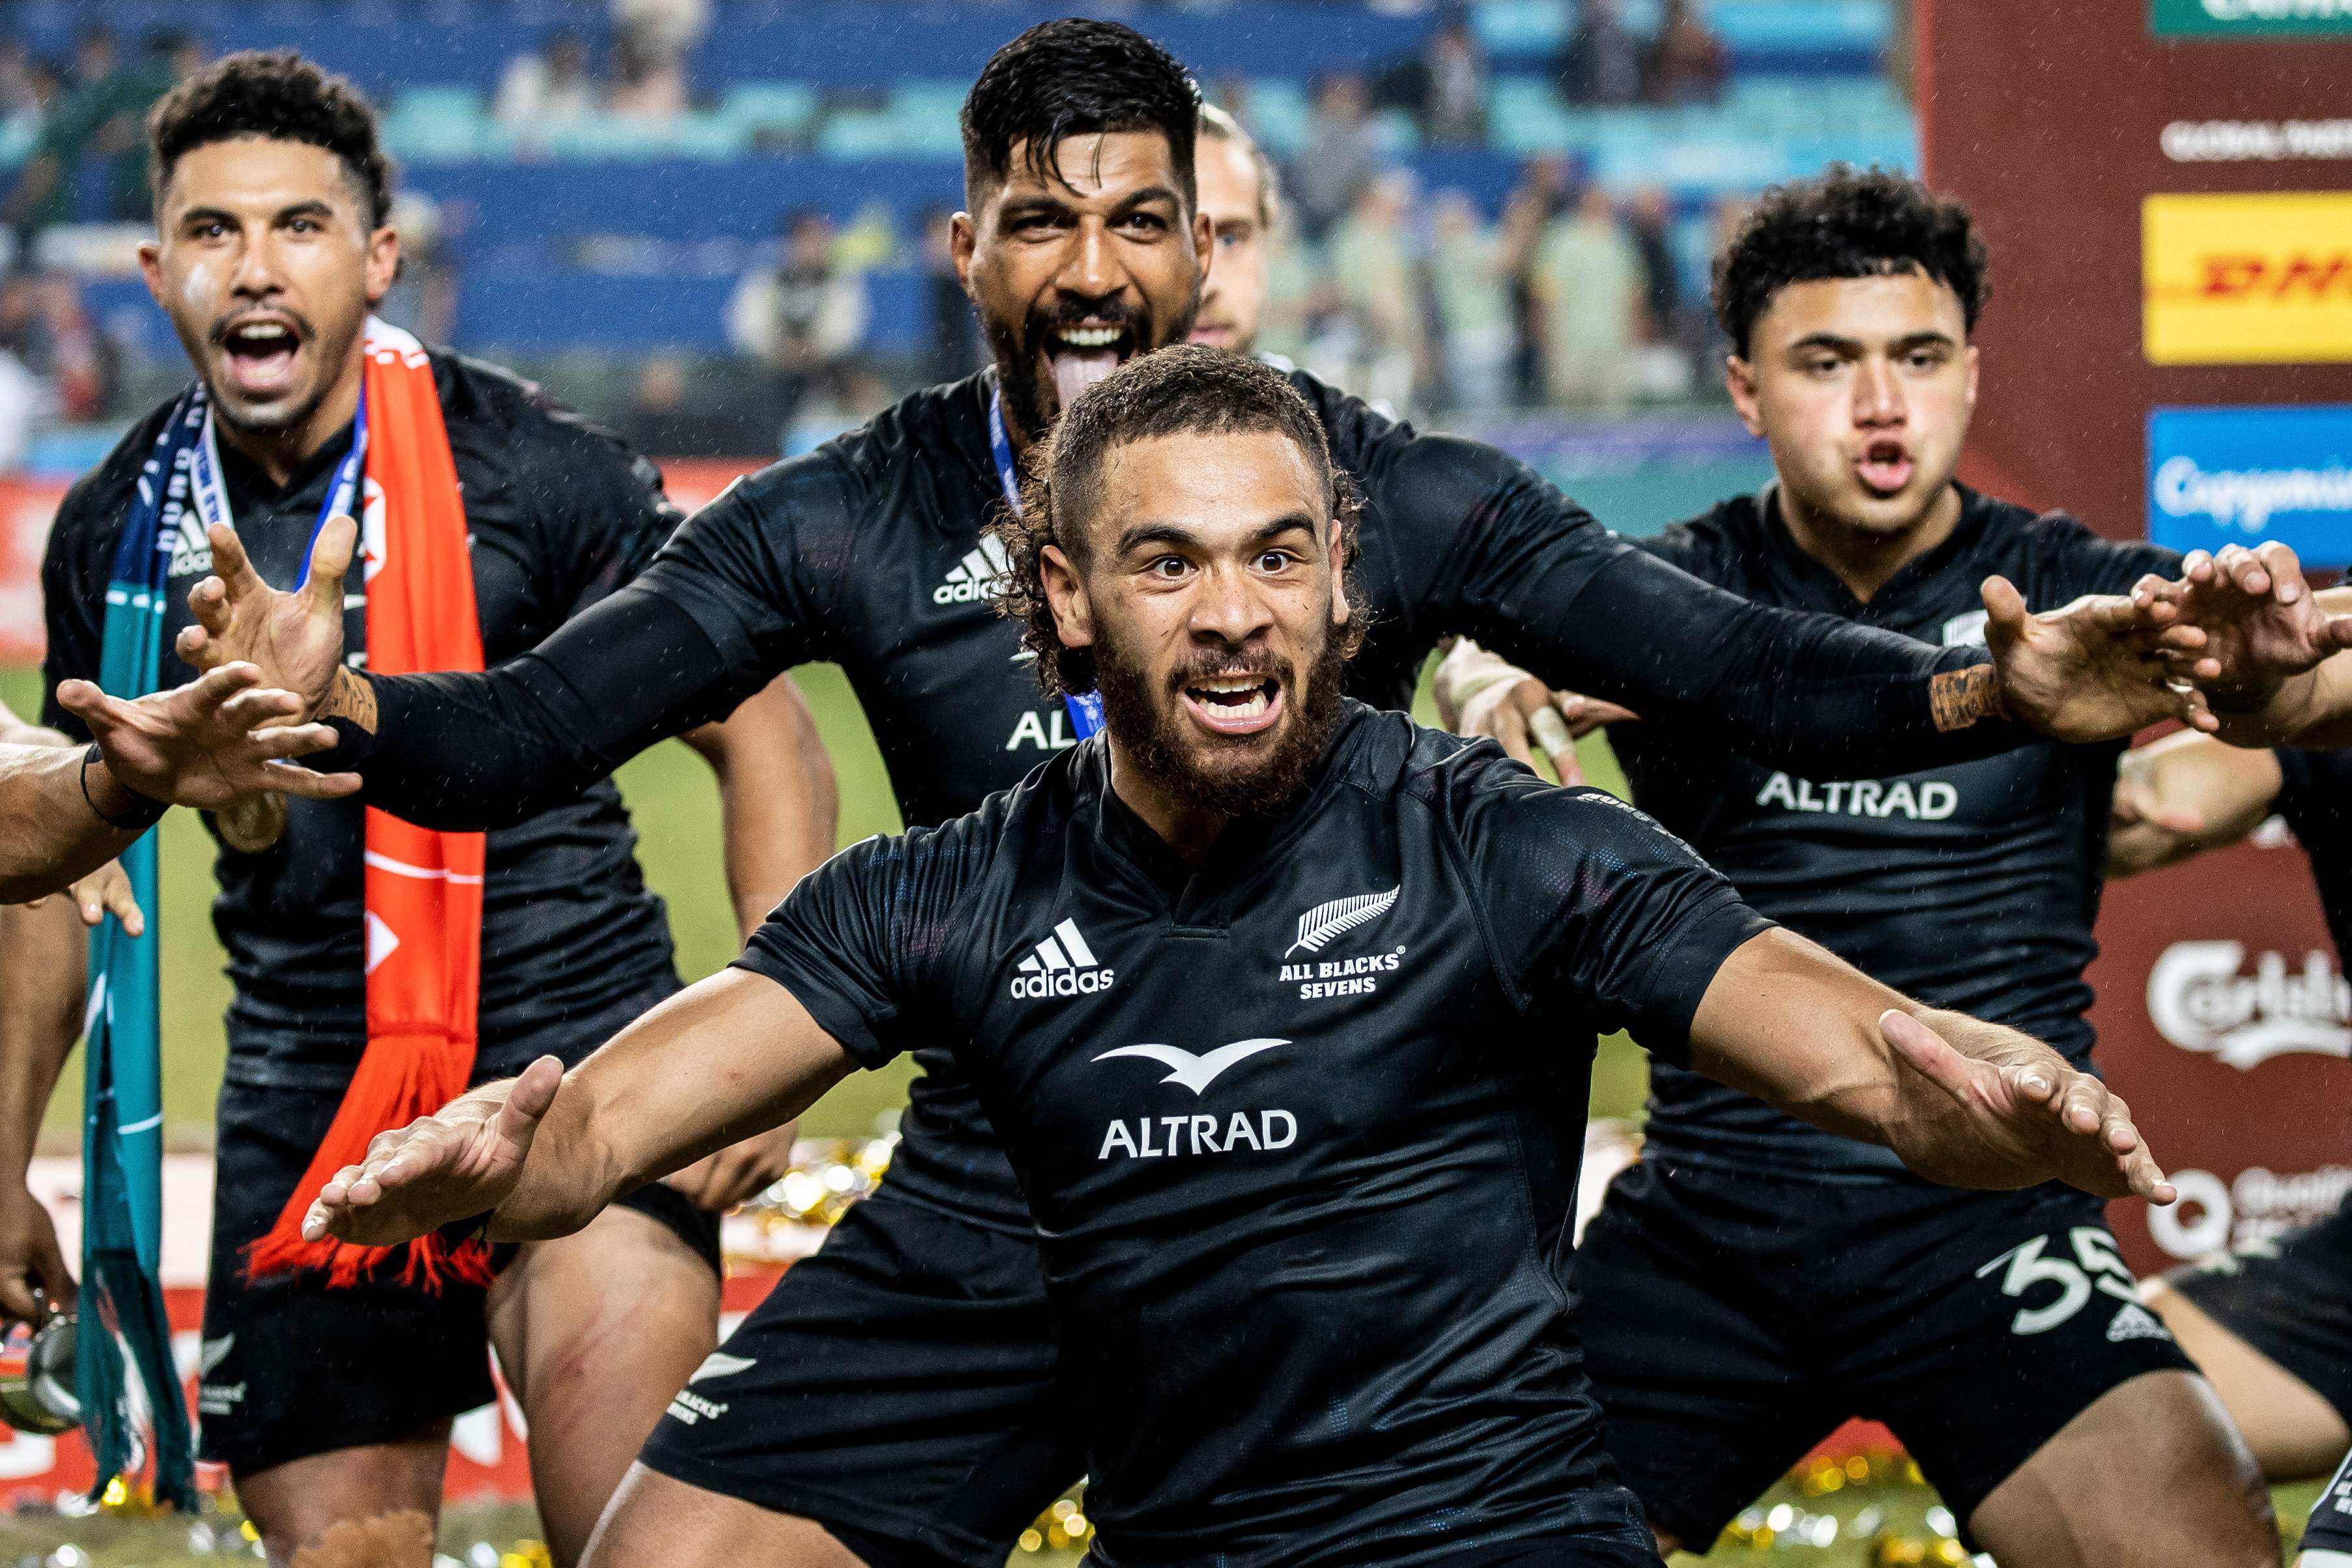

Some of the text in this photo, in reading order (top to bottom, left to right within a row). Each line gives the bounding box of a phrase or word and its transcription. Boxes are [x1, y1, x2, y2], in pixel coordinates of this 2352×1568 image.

[2200, 255, 2352, 303] DH
[1757, 771, 1958, 820] ALTRAD
[1011, 967, 1114, 1000] adidas
[1279, 964, 1314, 982] ALL
[1300, 976, 1376, 1000] SEVENS
[1098, 1109, 1297, 1160] ALTRAD
